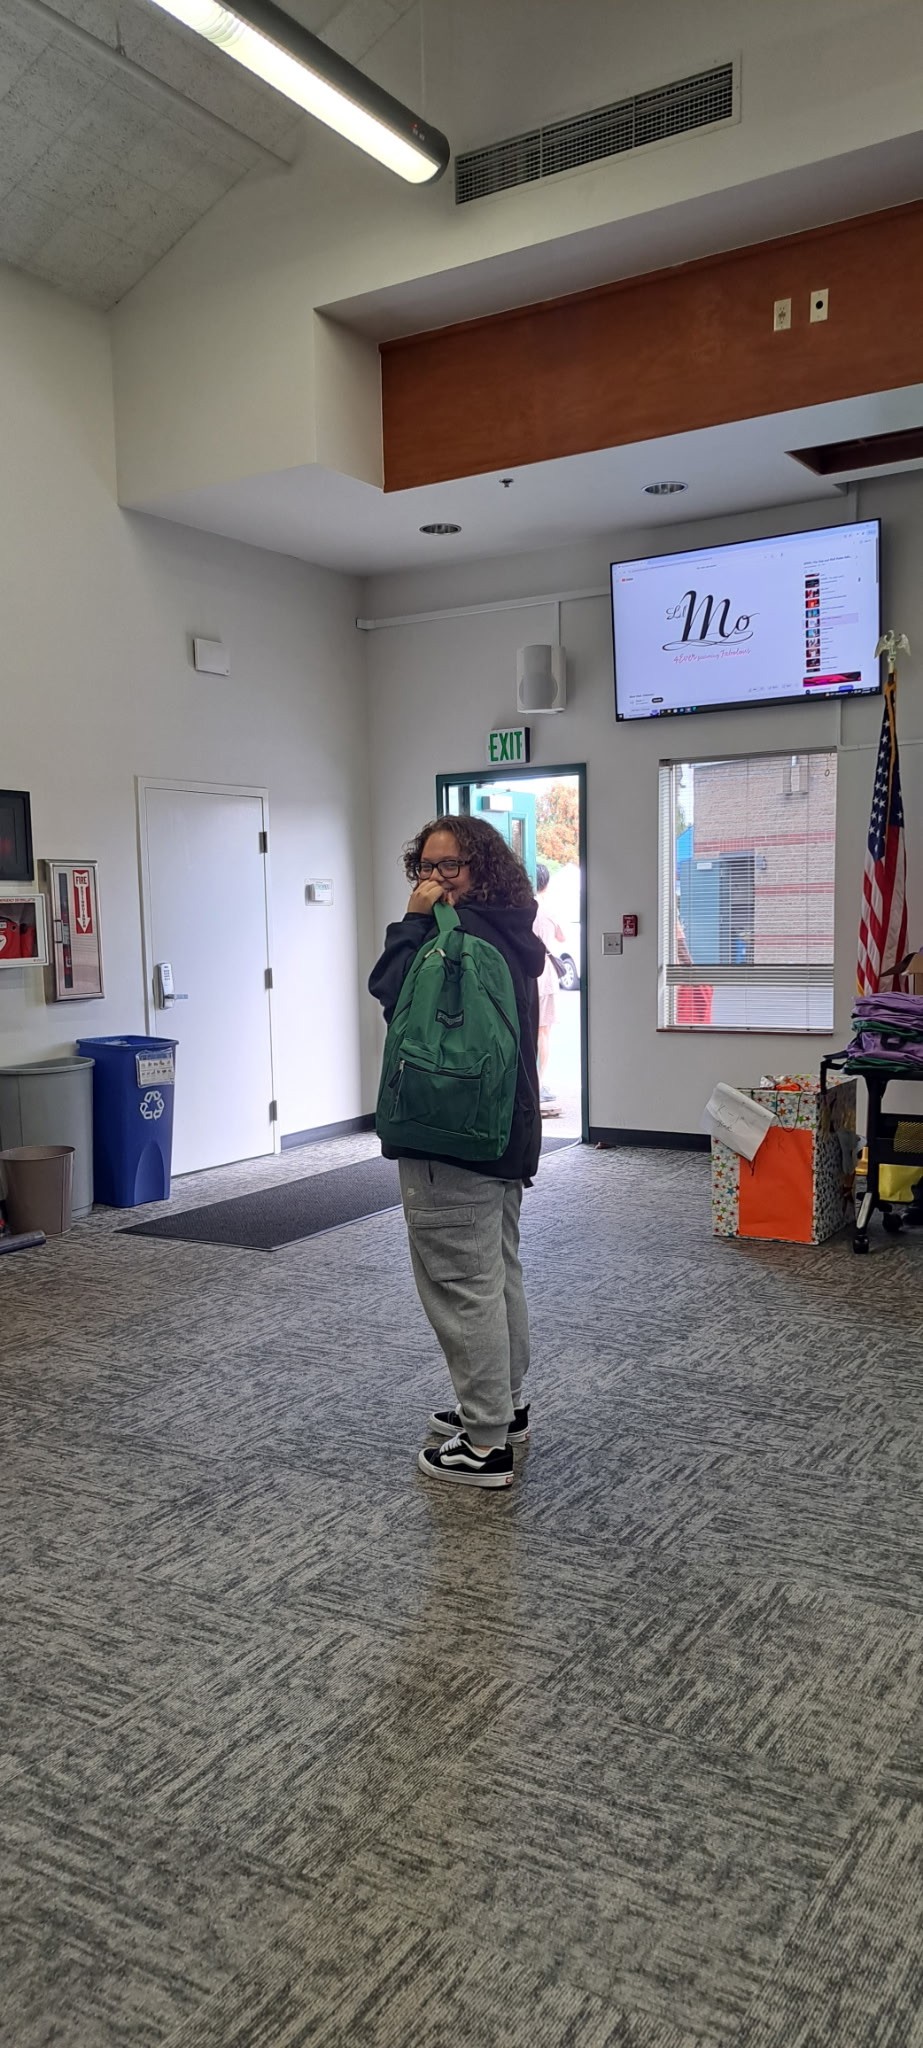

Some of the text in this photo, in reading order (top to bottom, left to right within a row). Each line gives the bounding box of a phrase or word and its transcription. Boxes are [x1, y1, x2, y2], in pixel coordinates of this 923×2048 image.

[677, 590, 759, 643] Mo
[490, 731, 522, 761] EXIT
[75, 876, 88, 885] FIRE
